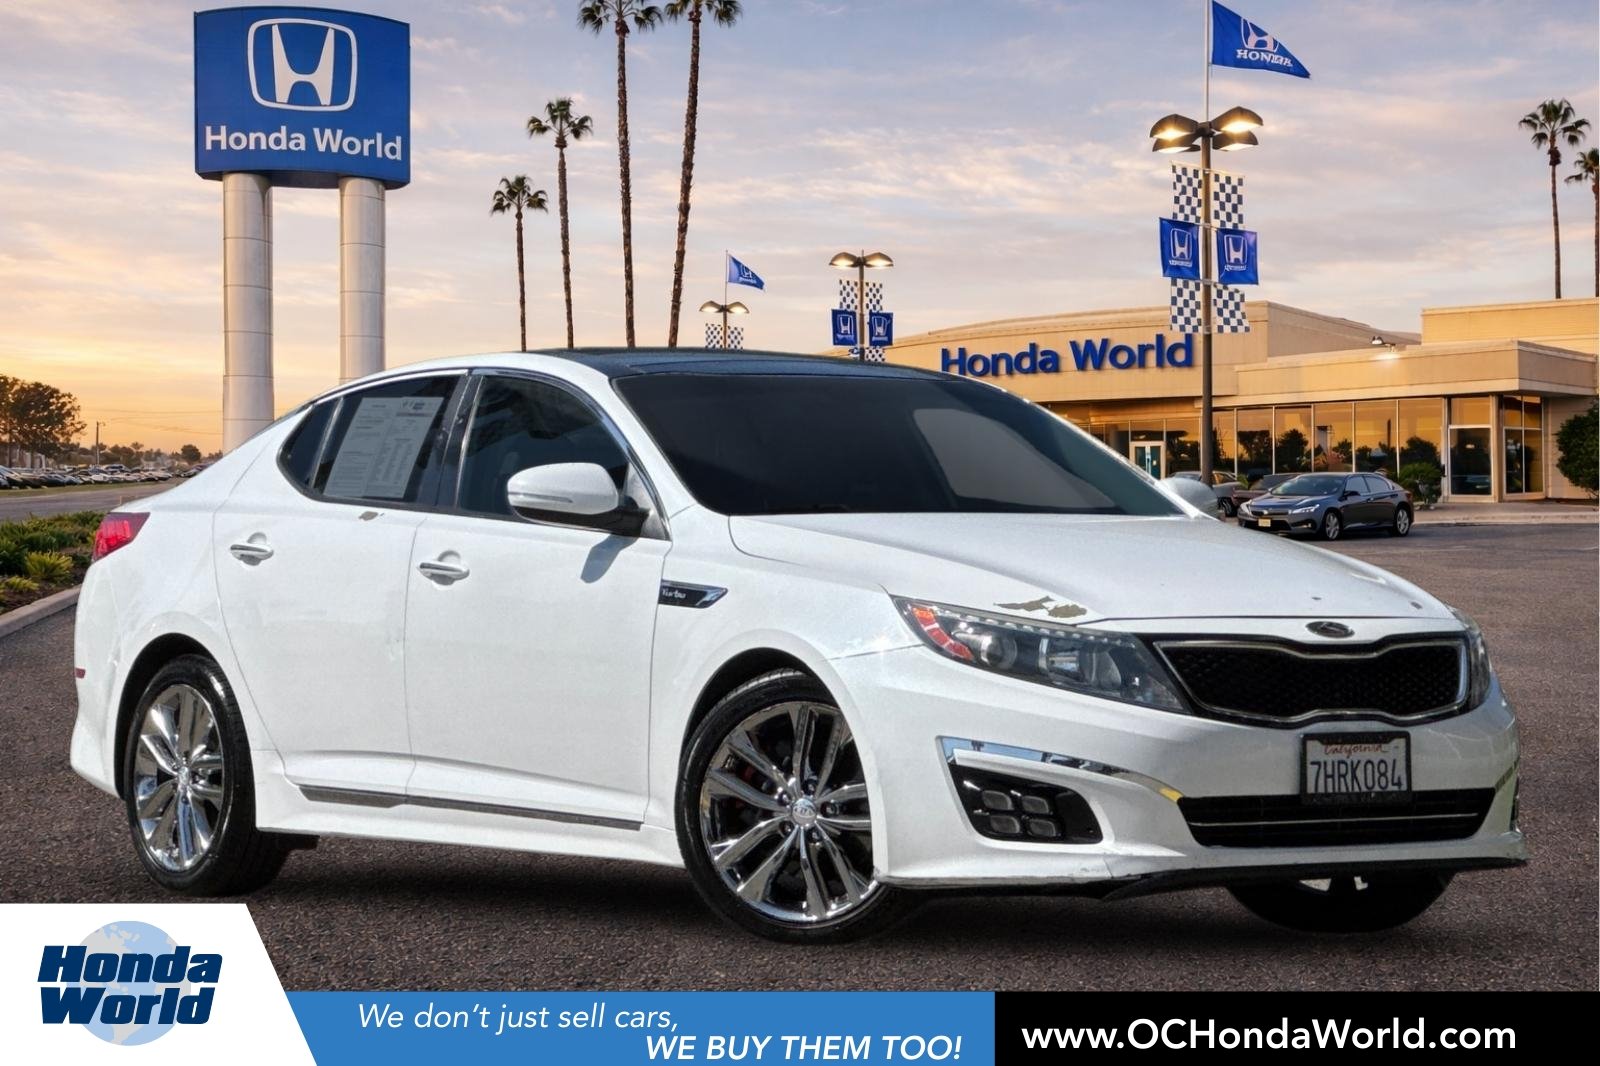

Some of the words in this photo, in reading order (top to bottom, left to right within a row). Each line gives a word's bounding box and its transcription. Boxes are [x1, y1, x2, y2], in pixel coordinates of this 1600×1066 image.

[205, 125, 306, 151] Honda
[312, 127, 402, 161] World
[941, 342, 1060, 377] Honda
[1069, 333, 1194, 371] World
[1310, 759, 1402, 793] 7HRK084
